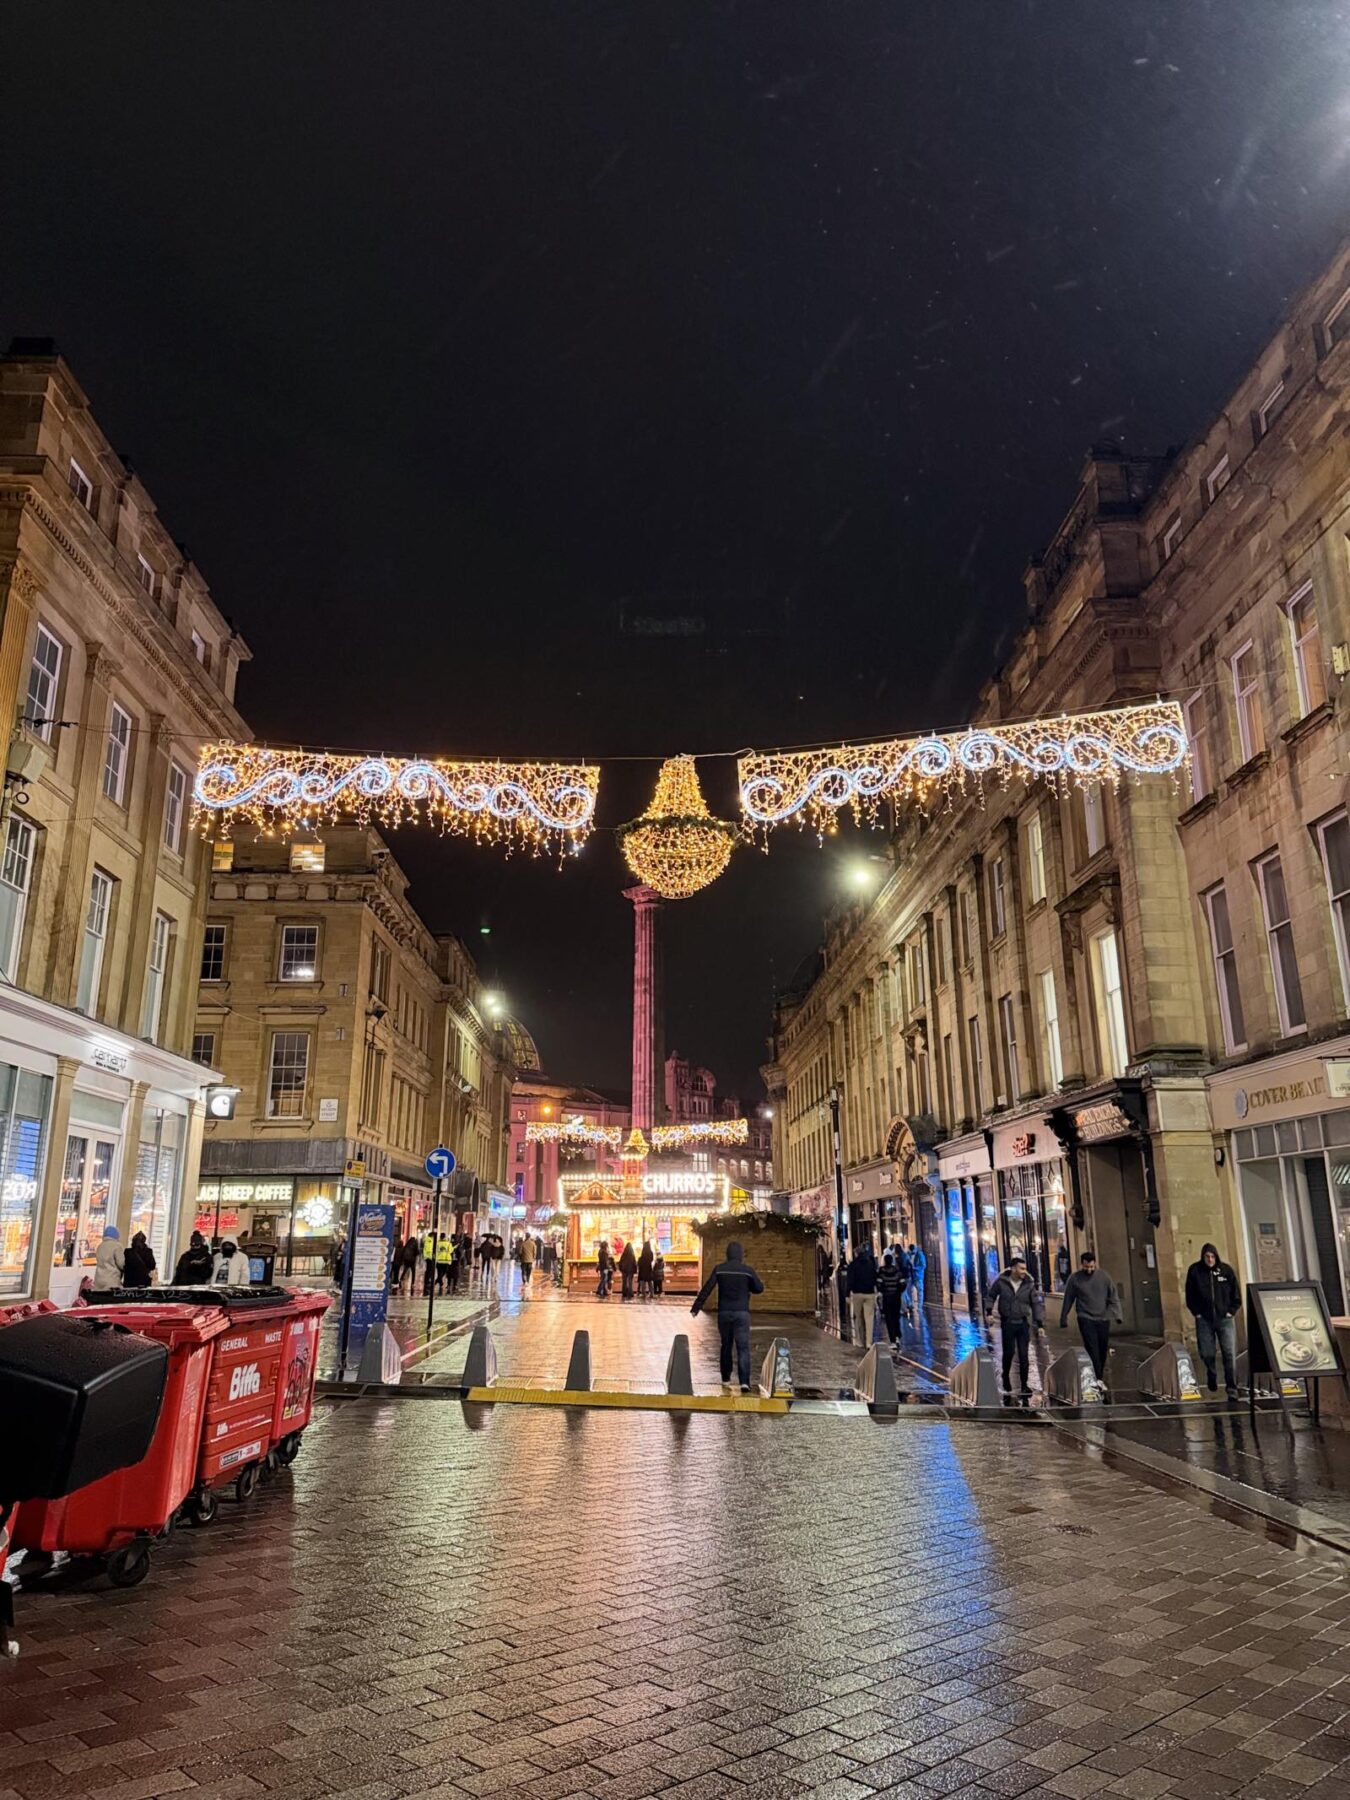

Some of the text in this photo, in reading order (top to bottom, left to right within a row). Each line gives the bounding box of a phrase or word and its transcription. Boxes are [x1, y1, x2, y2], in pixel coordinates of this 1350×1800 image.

[1249, 1087, 1288, 1109] COVER
[222, 1184, 254, 1201] SHEEP
[255, 1184, 292, 1201] COFFEE
[642, 1172, 715, 1193] CHURROS
[221, 1330, 282, 1352] GENERAL WASTE
[229, 1362, 261, 1401] Biffa
